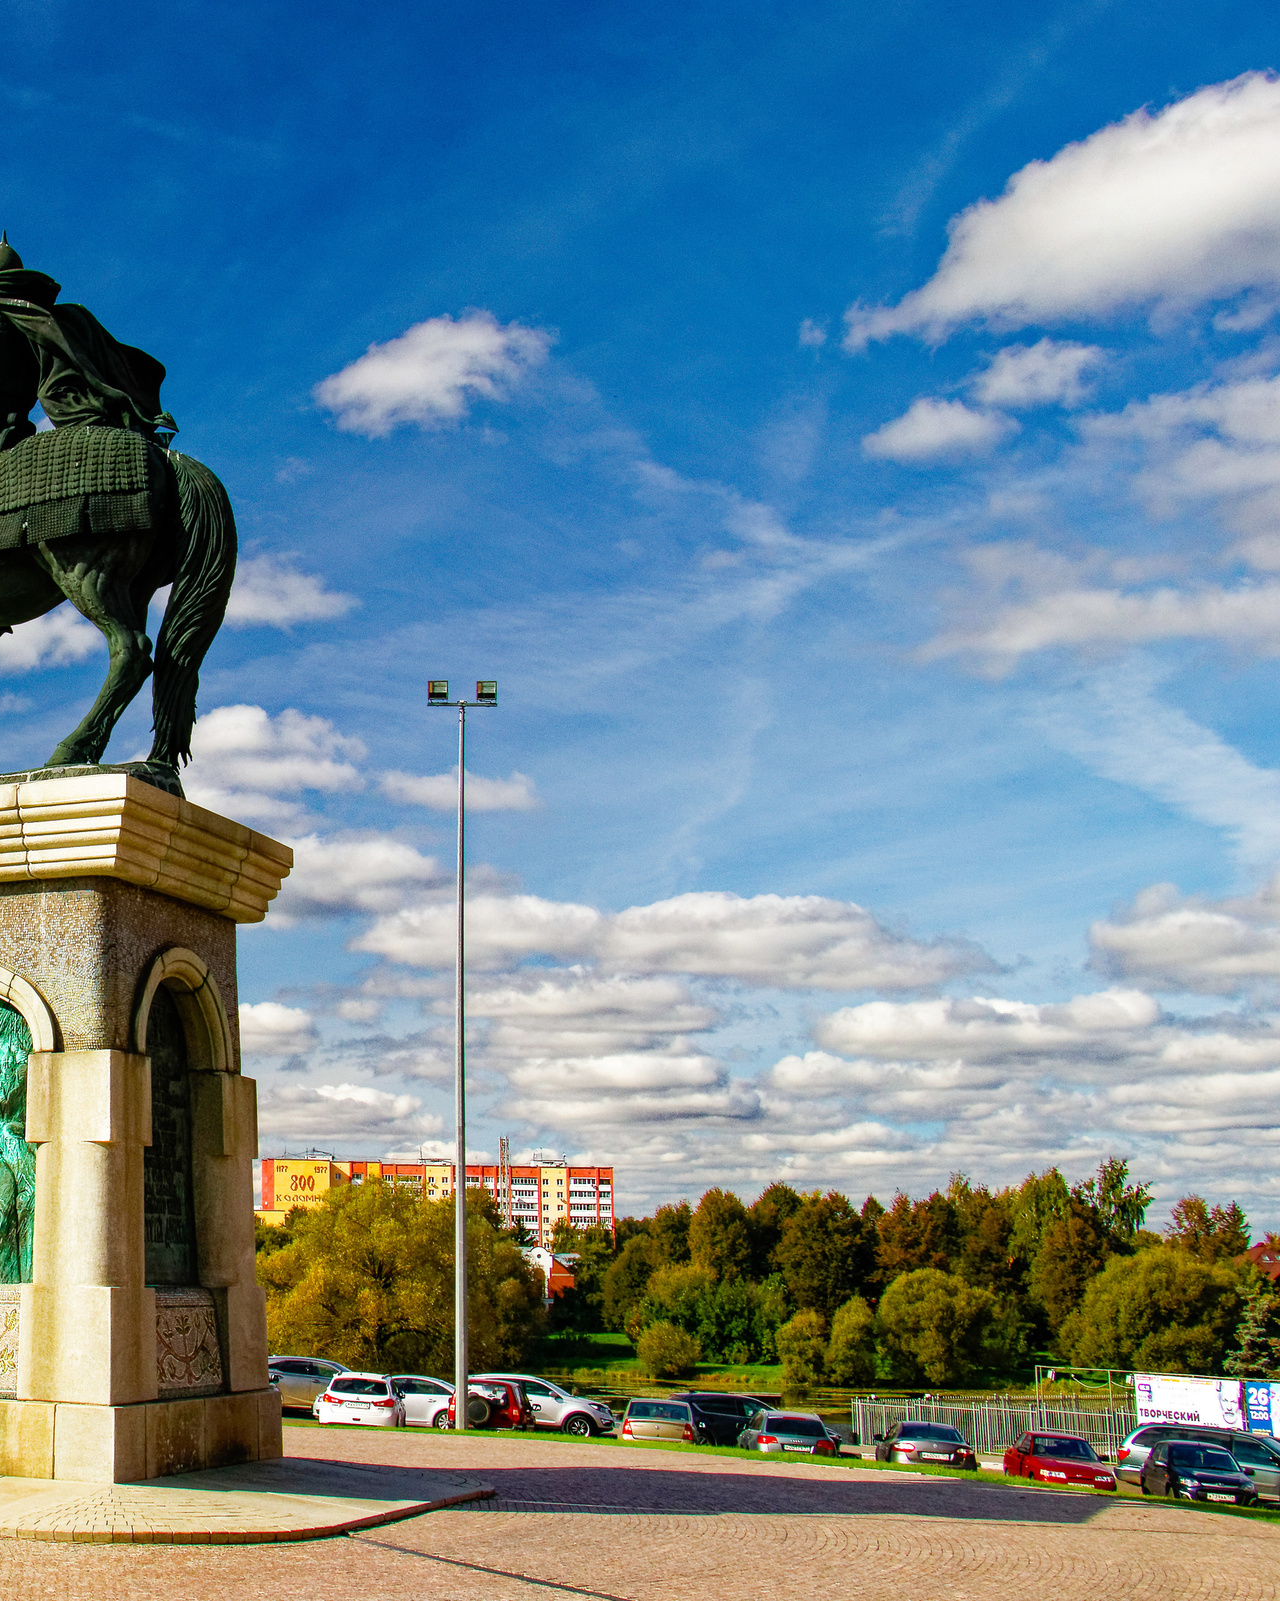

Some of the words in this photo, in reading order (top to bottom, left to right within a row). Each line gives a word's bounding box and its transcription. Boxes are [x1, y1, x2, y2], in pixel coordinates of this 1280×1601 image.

[290, 1174, 315, 1192] 800
[276, 1194, 323, 1202] КОЛОМН
[1247, 1387, 1270, 1406] 26
[1139, 1408, 1200, 1423] ТВОРЧЕСКИЙ
[1250, 1411, 1269, 1421] 12:00
